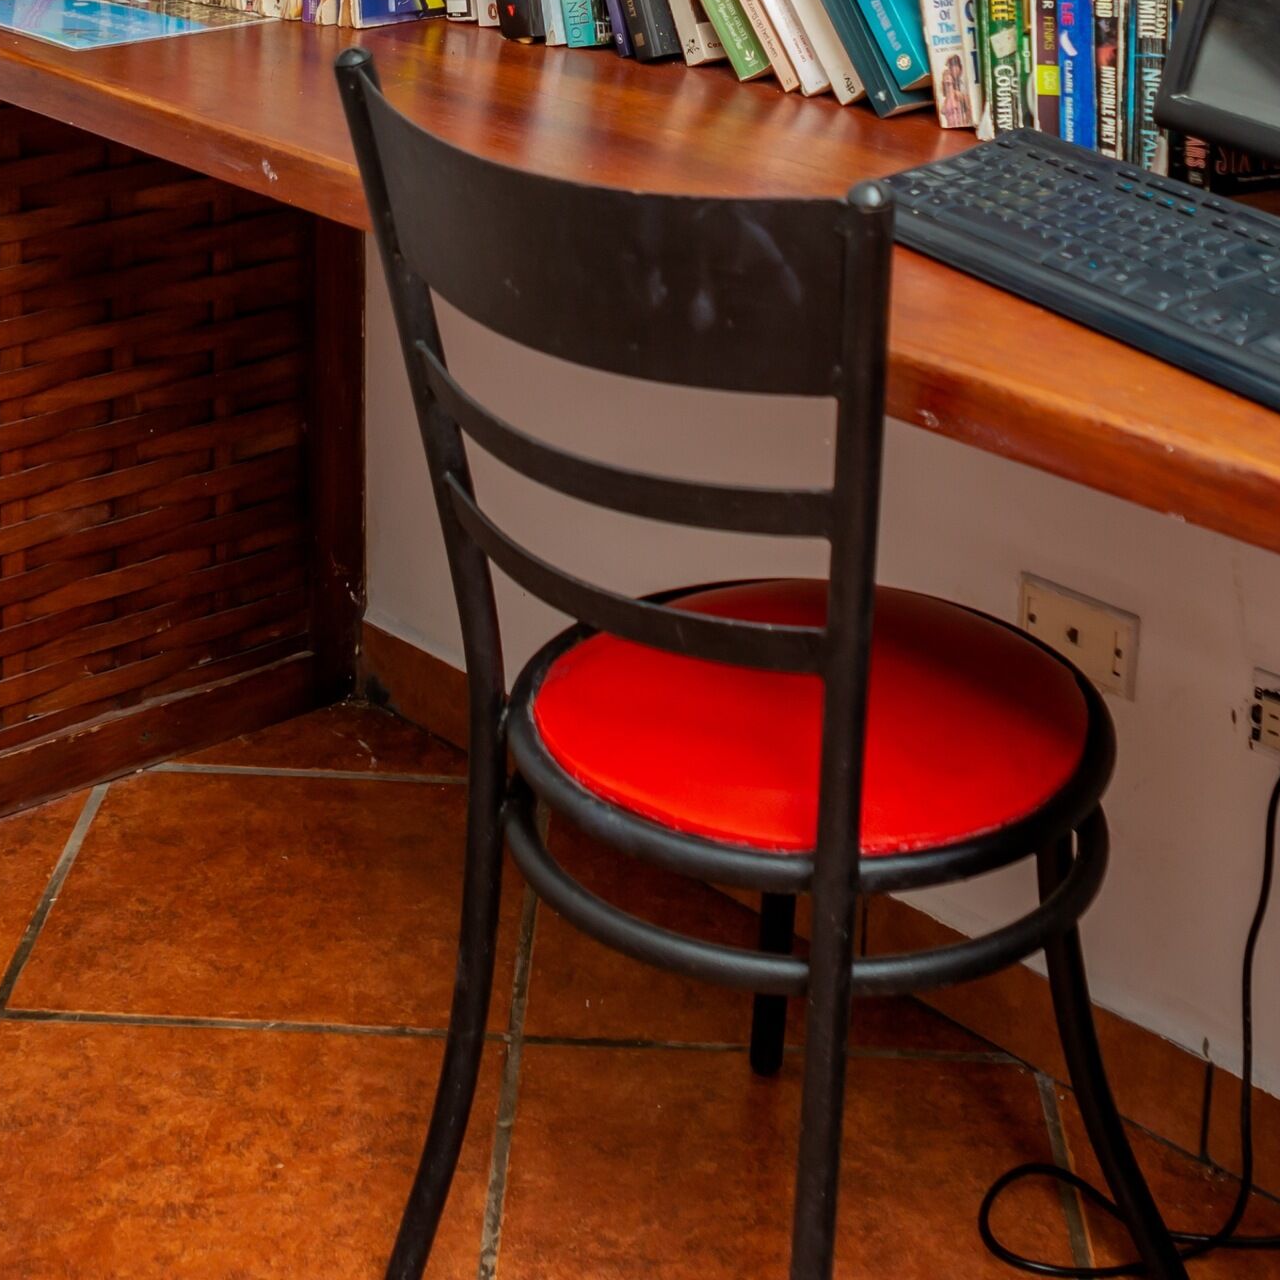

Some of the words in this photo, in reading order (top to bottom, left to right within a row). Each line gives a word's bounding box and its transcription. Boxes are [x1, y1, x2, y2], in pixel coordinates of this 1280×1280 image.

[937, 22, 956, 33] The
[939, 9, 952, 21] Of
[1061, 1, 1074, 27] LIE
[932, 34, 963, 46] Dream
[1043, 16, 1054, 51] FENIKS
[841, 75, 857, 95] dtv
[1064, 59, 1073, 93] CLAIRE
[994, 64, 1013, 131] COUNTRY
[1100, 66, 1116, 118] INVISIBLE
[1064, 95, 1074, 143] SHELDON
[1101, 118, 1116, 147] PREY
